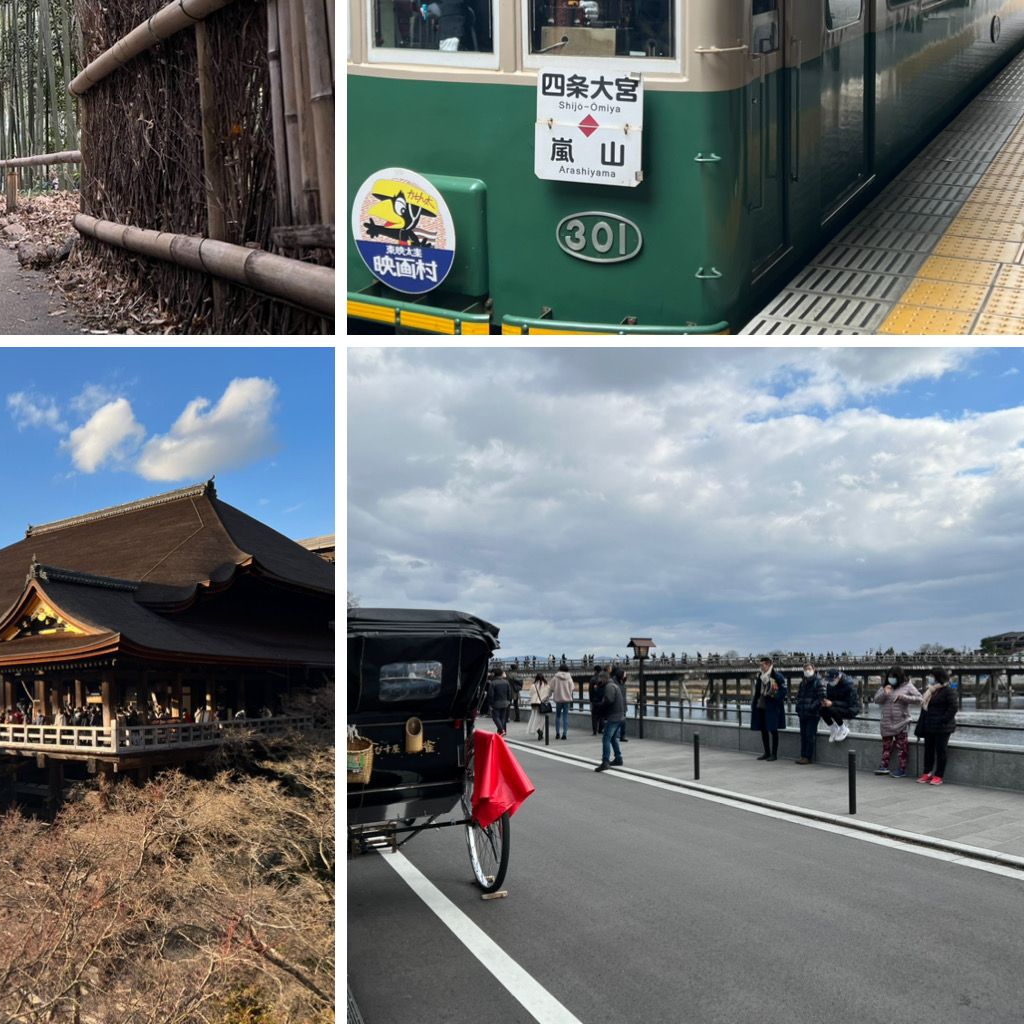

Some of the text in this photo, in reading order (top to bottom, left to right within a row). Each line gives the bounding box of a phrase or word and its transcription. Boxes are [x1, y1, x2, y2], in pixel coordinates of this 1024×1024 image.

[542, 73, 638, 103] 四条大宮
[559, 165, 616, 178] Arashiyama
[564, 219, 626, 256] 301
[372, 255, 438, 283] 映画村
